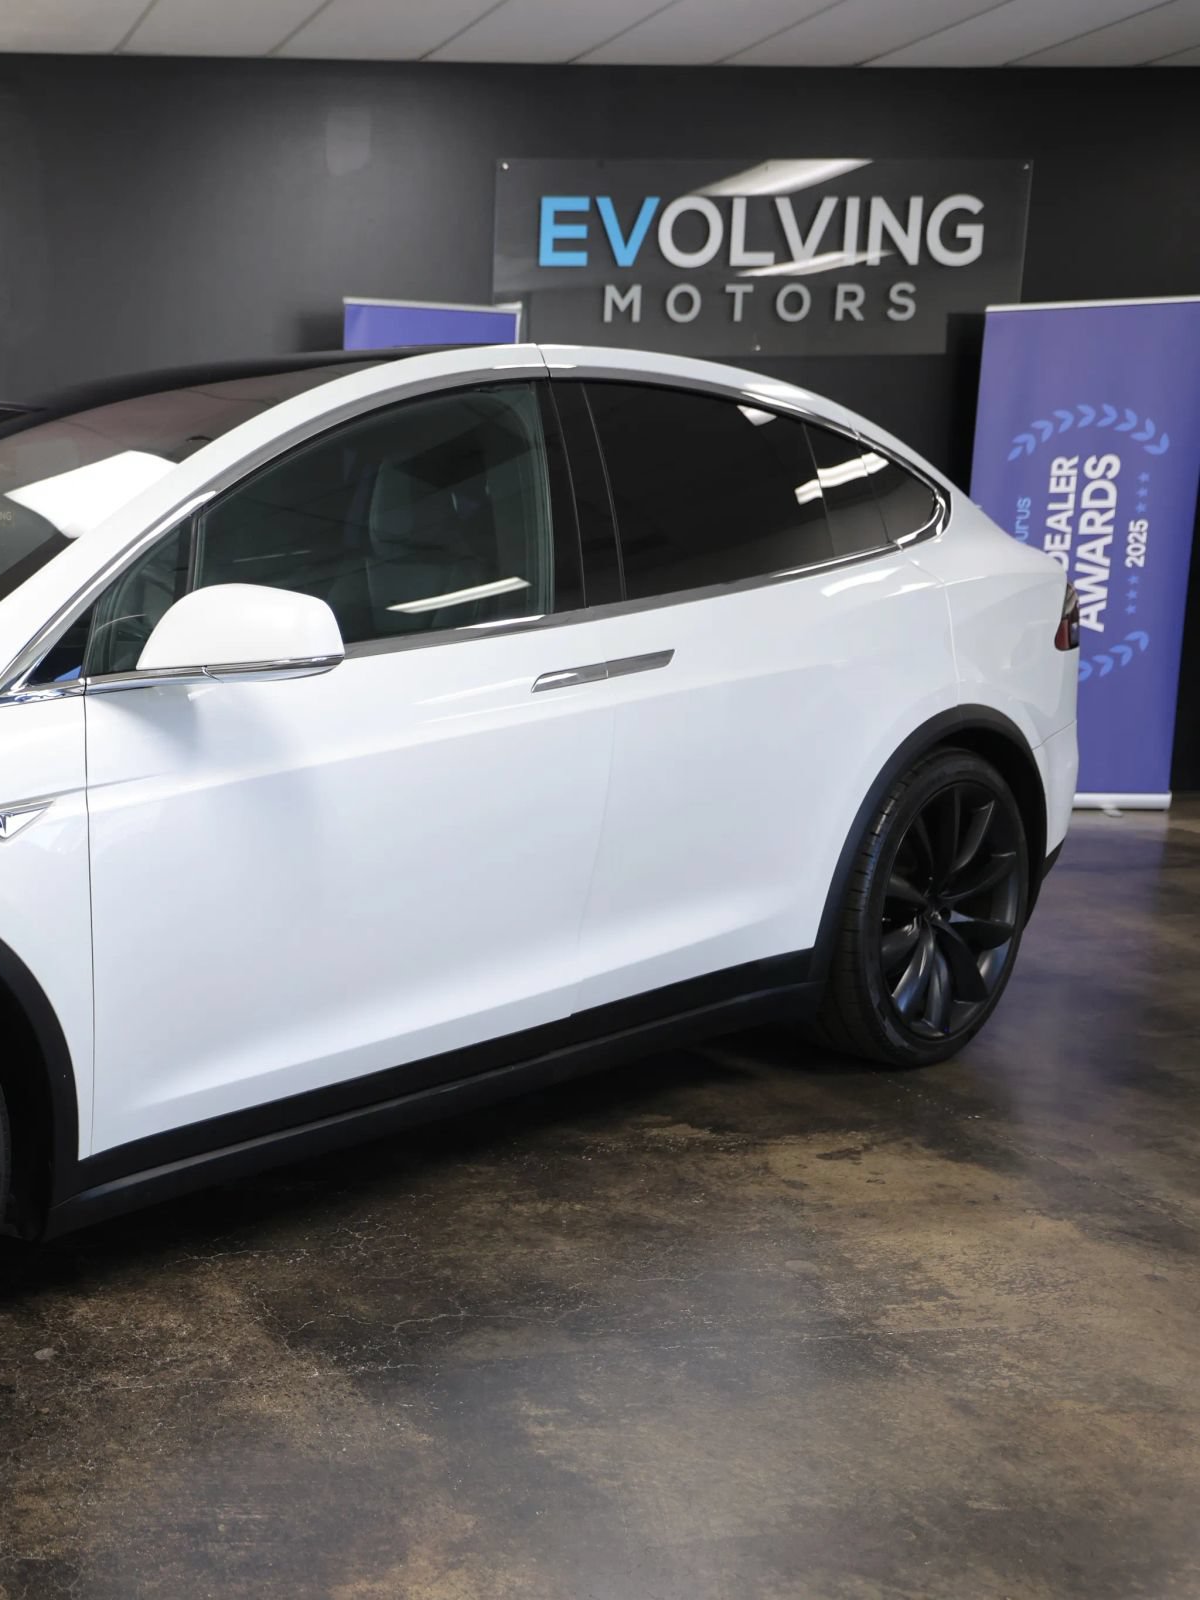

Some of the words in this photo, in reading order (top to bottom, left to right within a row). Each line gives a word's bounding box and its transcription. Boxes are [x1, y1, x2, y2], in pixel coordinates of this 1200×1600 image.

[538, 193, 985, 269] EVOLVING
[602, 281, 917, 323] MOTORS
[1014, 496, 1032, 545] urus
[1073, 453, 1121, 633] AWARDS
[1124, 518, 1149, 569] 2025
